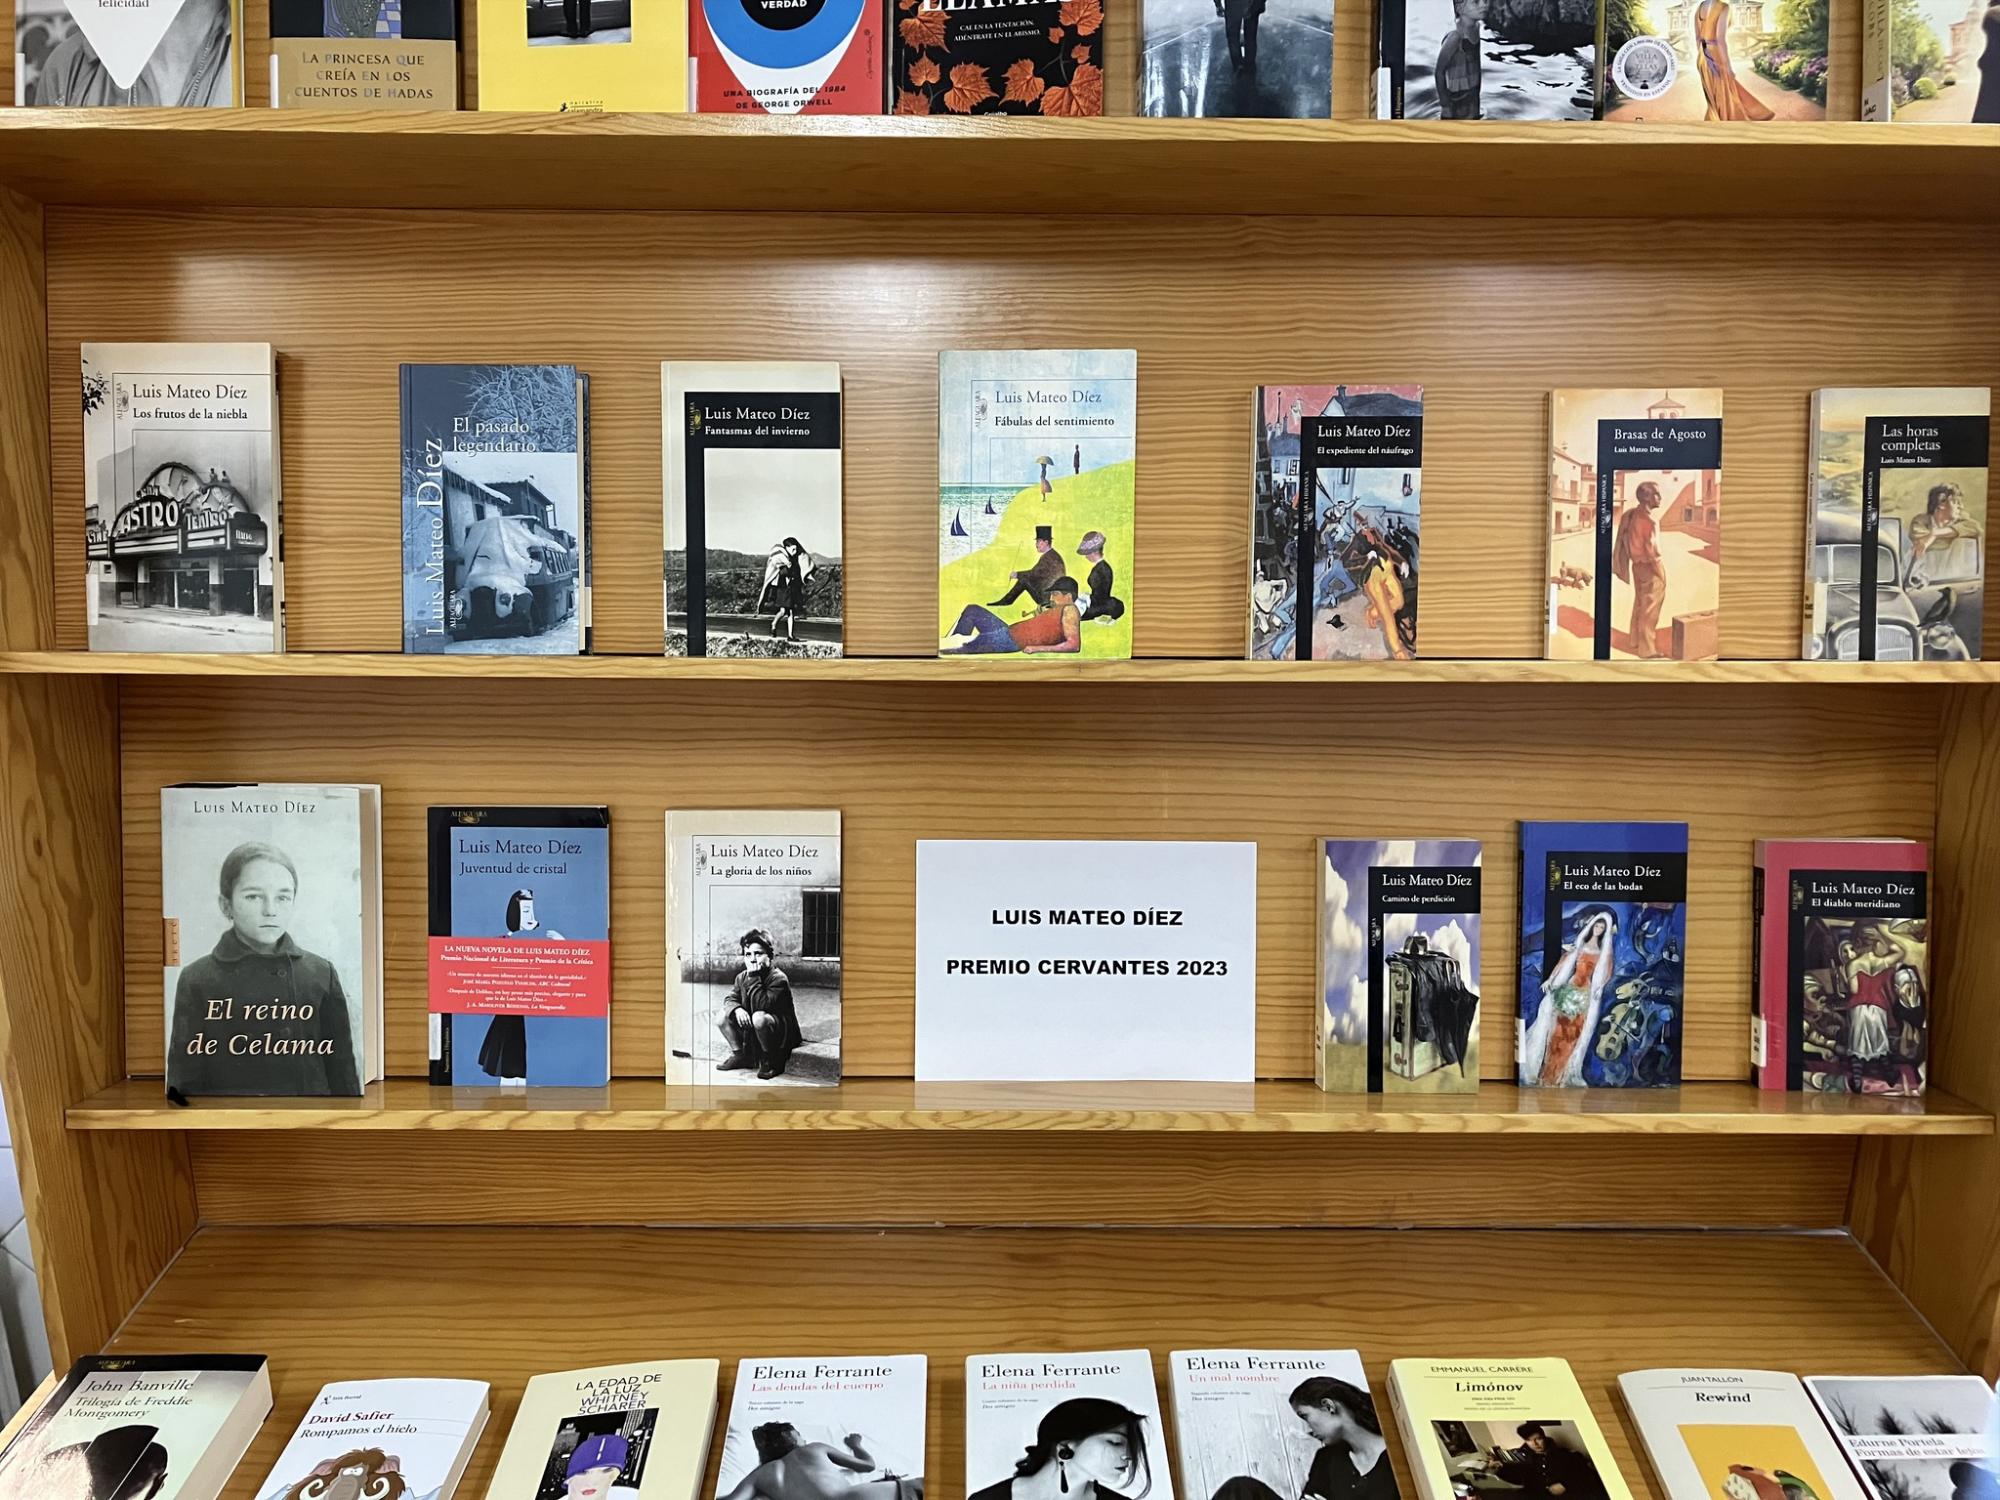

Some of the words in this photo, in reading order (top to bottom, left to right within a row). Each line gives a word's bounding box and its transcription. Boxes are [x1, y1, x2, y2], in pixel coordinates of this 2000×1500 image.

[761, 0, 808, 9] VERDAD
[325, 54, 391, 65] PRINCESA
[396, 55, 425, 66] QUE
[362, 71, 380, 81] EN
[294, 87, 358, 98] CUENTOS
[364, 88, 382, 98] DE
[388, 88, 433, 99] HADAS
[824, 85, 846, 93] 1984
[752, 100, 790, 108] GEORGE
[793, 98, 832, 107] ORWELL
[133, 384, 162, 398] Luis
[167, 384, 210, 399] Mateo
[216, 384, 248, 399] Díez
[996, 391, 1022, 403] Luis
[1026, 391, 1067, 403] Mateo
[1072, 390, 1101, 403] Díez
[133, 407, 151, 418] Los
[155, 407, 186, 419] frutos
[189, 408, 201, 419] de
[204, 408, 213, 419] la
[216, 408, 248, 419] niebla
[705, 407, 732, 420] Luis
[736, 407, 776, 420] Mateo
[781, 407, 811, 420] Díez
[453, 416, 469, 433] El
[475, 416, 530, 437] pasado
[995, 416, 1033, 426] Fábulas
[1036, 416, 1051, 426] del
[1053, 416, 1115, 426] sentimiento
[705, 426, 752, 435] Fantasmas
[755, 426, 769, 435] del
[771, 426, 810, 436] invierno
[1318, 425, 1342, 437] Luis
[1345, 425, 1381, 437] Mateo
[1384, 424, 1411, 437] Díez
[1614, 428, 1648, 440] Brasas
[1651, 427, 1664, 439] de
[1668, 428, 1706, 442] Agosto
[1883, 424, 1903, 437] Las
[1906, 423, 1939, 437] horas
[453, 436, 536, 457] legendario
[1326, 446, 1366, 456] expediente
[1381, 446, 1414, 456] náufrago
[1881, 437, 1941, 453] completas
[416, 438, 443, 508] Díez
[425, 517, 445, 582] Mateo
[425, 590, 445, 635] Luis
[459, 839, 490, 854] Luis
[495, 839, 542, 854] Mateo
[548, 839, 582, 854] Díez
[711, 844, 738, 857] Luis
[742, 844, 784, 857] Mateo
[789, 844, 818, 857] Díez
[459, 861, 512, 876] Juventud
[516, 861, 530, 874] de
[533, 862, 567, 874] cristal
[711, 866, 722, 875] La
[725, 866, 753, 878] gloria
[755, 866, 767, 875] de
[769, 866, 783, 875] los
[785, 866, 812, 875] niños
[1564, 864, 1589, 876] Luis
[1593, 865, 1630, 877] Mateo
[1634, 865, 1661, 877] Díez
[1382, 873, 1406, 886] Luis
[1409, 874, 1444, 886] Mateo
[1446, 873, 1472, 886] Díez
[1563, 881, 1573, 890] El
[1591, 881, 1602, 890] de
[1604, 881, 1616, 890] las
[1618, 881, 1643, 891] bodas
[1811, 881, 1838, 894] Luis
[1842, 882, 1882, 894] Mateo
[1886, 883, 1915, 895] Díez
[1421, 895, 1455, 904] perdición
[1823, 898, 1852, 907] diablo
[1854, 899, 1901, 908] meridiano
[992, 909, 1042, 925] LUIS
[1049, 909, 1125, 926] MATEO
[1133, 907, 1183, 926] DÍEZ
[455, 945, 481, 953] NUEVA
[482, 946, 512, 954] NOVELA
[946, 959, 1031, 975] PREMIO
[1038, 959, 1170, 976] CERVANTES
[1176, 960, 1228, 976] 2023
[204, 997, 232, 1020] El
[243, 998, 314, 1021] reino
[186, 1032, 218, 1056] de
[229, 1031, 334, 1056] Celama
[1187, 1356, 1240, 1370] Elena
[1247, 1356, 1326, 1370] Ferrante
[753, 1365, 806, 1379] Elena
[814, 1365, 892, 1378] Ferrante
[982, 1364, 1034, 1378] Elena
[1043, 1364, 1120, 1376] Ferrante
[576, 1381, 594, 1391] LA
[598, 1376, 639, 1388] EDAD
[643, 1373, 662, 1383] DE
[1189, 1374, 1206, 1383] Un
[1210, 1373, 1232, 1382] mal
[1236, 1373, 1280, 1382] nombre
[80, 1380, 123, 1393] John
[128, 1379, 194, 1391] Banville
[592, 1387, 610, 1397] LA
[615, 1383, 642, 1394] LUZ
[751, 1383, 772, 1392] Las
[775, 1382, 817, 1391] deudas
[821, 1381, 840, 1390] del
[843, 1382, 884, 1391] cuerpo
[982, 1382, 997, 1390] La
[1001, 1381, 1027, 1390] niña
[1030, 1380, 1076, 1391] perdida
[1456, 1382, 1523, 1392] Limónov
[124, 1396, 141, 1406] de
[144, 1396, 193, 1406] Freddie
[581, 1391, 649, 1406] WHITNEY
[1695, 1392, 1751, 1402] Rewind
[64, 1408, 151, 1420] Montgomery
[578, 1400, 647, 1415] SCHARER
[308, 1413, 351, 1425] David
[352, 1410, 395, 1421] Safier
[300, 1426, 370, 1439] Rompamos
[373, 1424, 385, 1434] el
[385, 1424, 418, 1434] hielo
[1849, 1439, 1896, 1447] Edurne
[1898, 1438, 1944, 1447] Portela
[1854, 1448, 1904, 1457] Formas
[1922, 1447, 1954, 1456] estar
